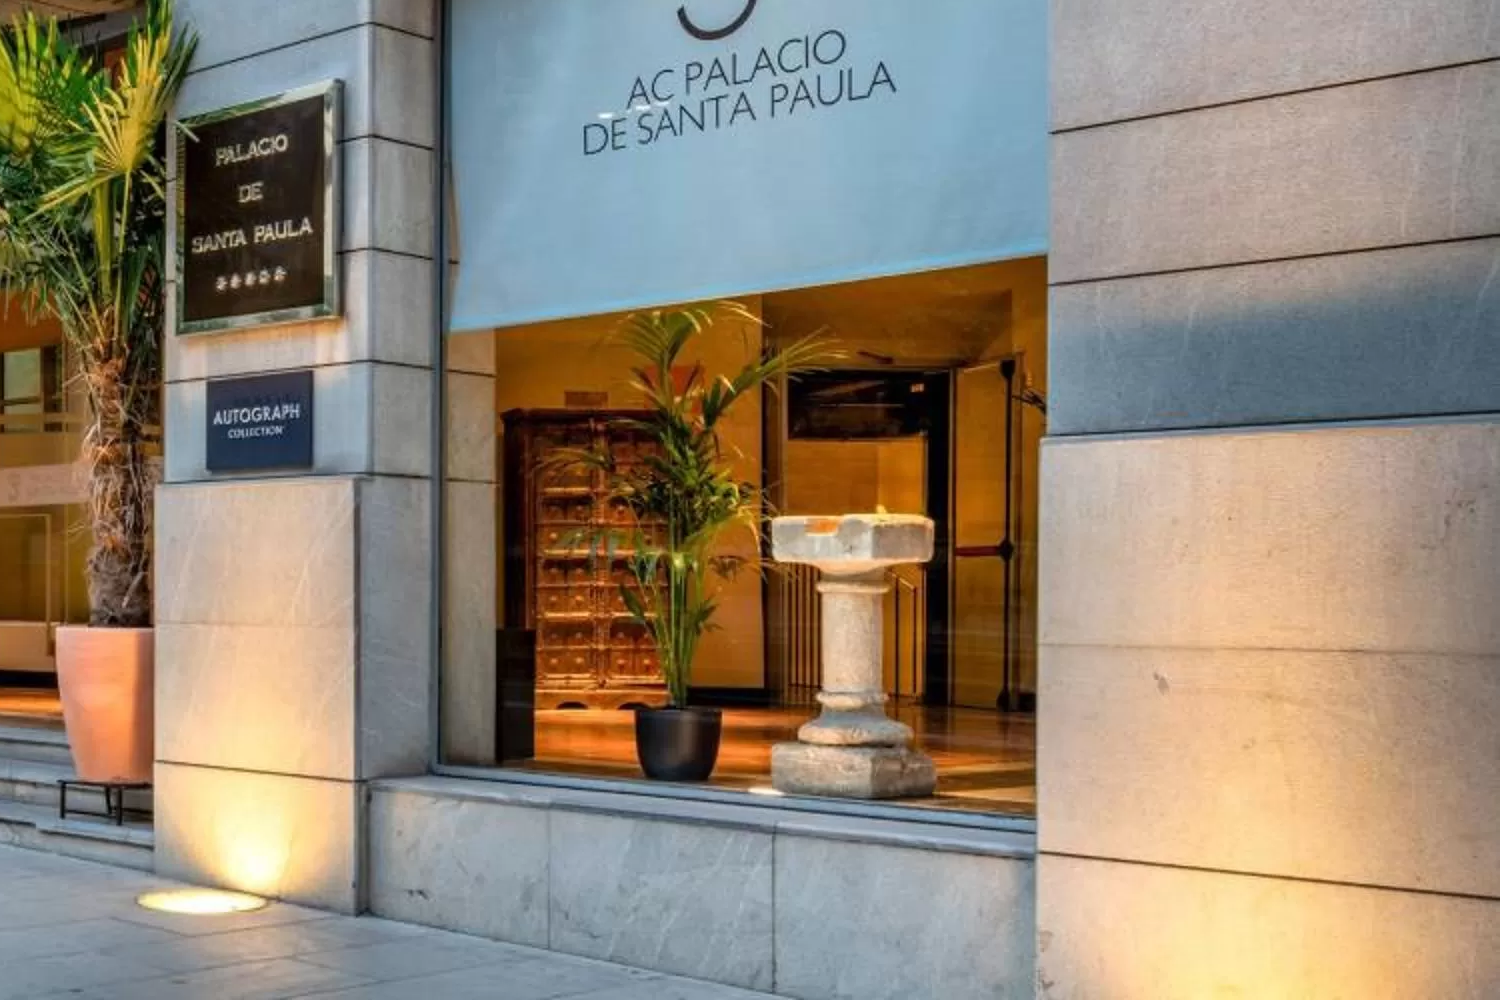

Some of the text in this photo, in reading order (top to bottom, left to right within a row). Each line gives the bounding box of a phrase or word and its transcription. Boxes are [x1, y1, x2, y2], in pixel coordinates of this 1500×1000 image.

[626, 29, 847, 109] AC PALACIO
[582, 60, 897, 156] DE SANTA PAULA
[215, 133, 289, 167] PALACIO
[238, 181, 264, 204] DE
[191, 216, 314, 254] SANTA PAULA
[212, 403, 301, 425] AUTOGRAPH
[227, 425, 284, 439] COLLECTION
